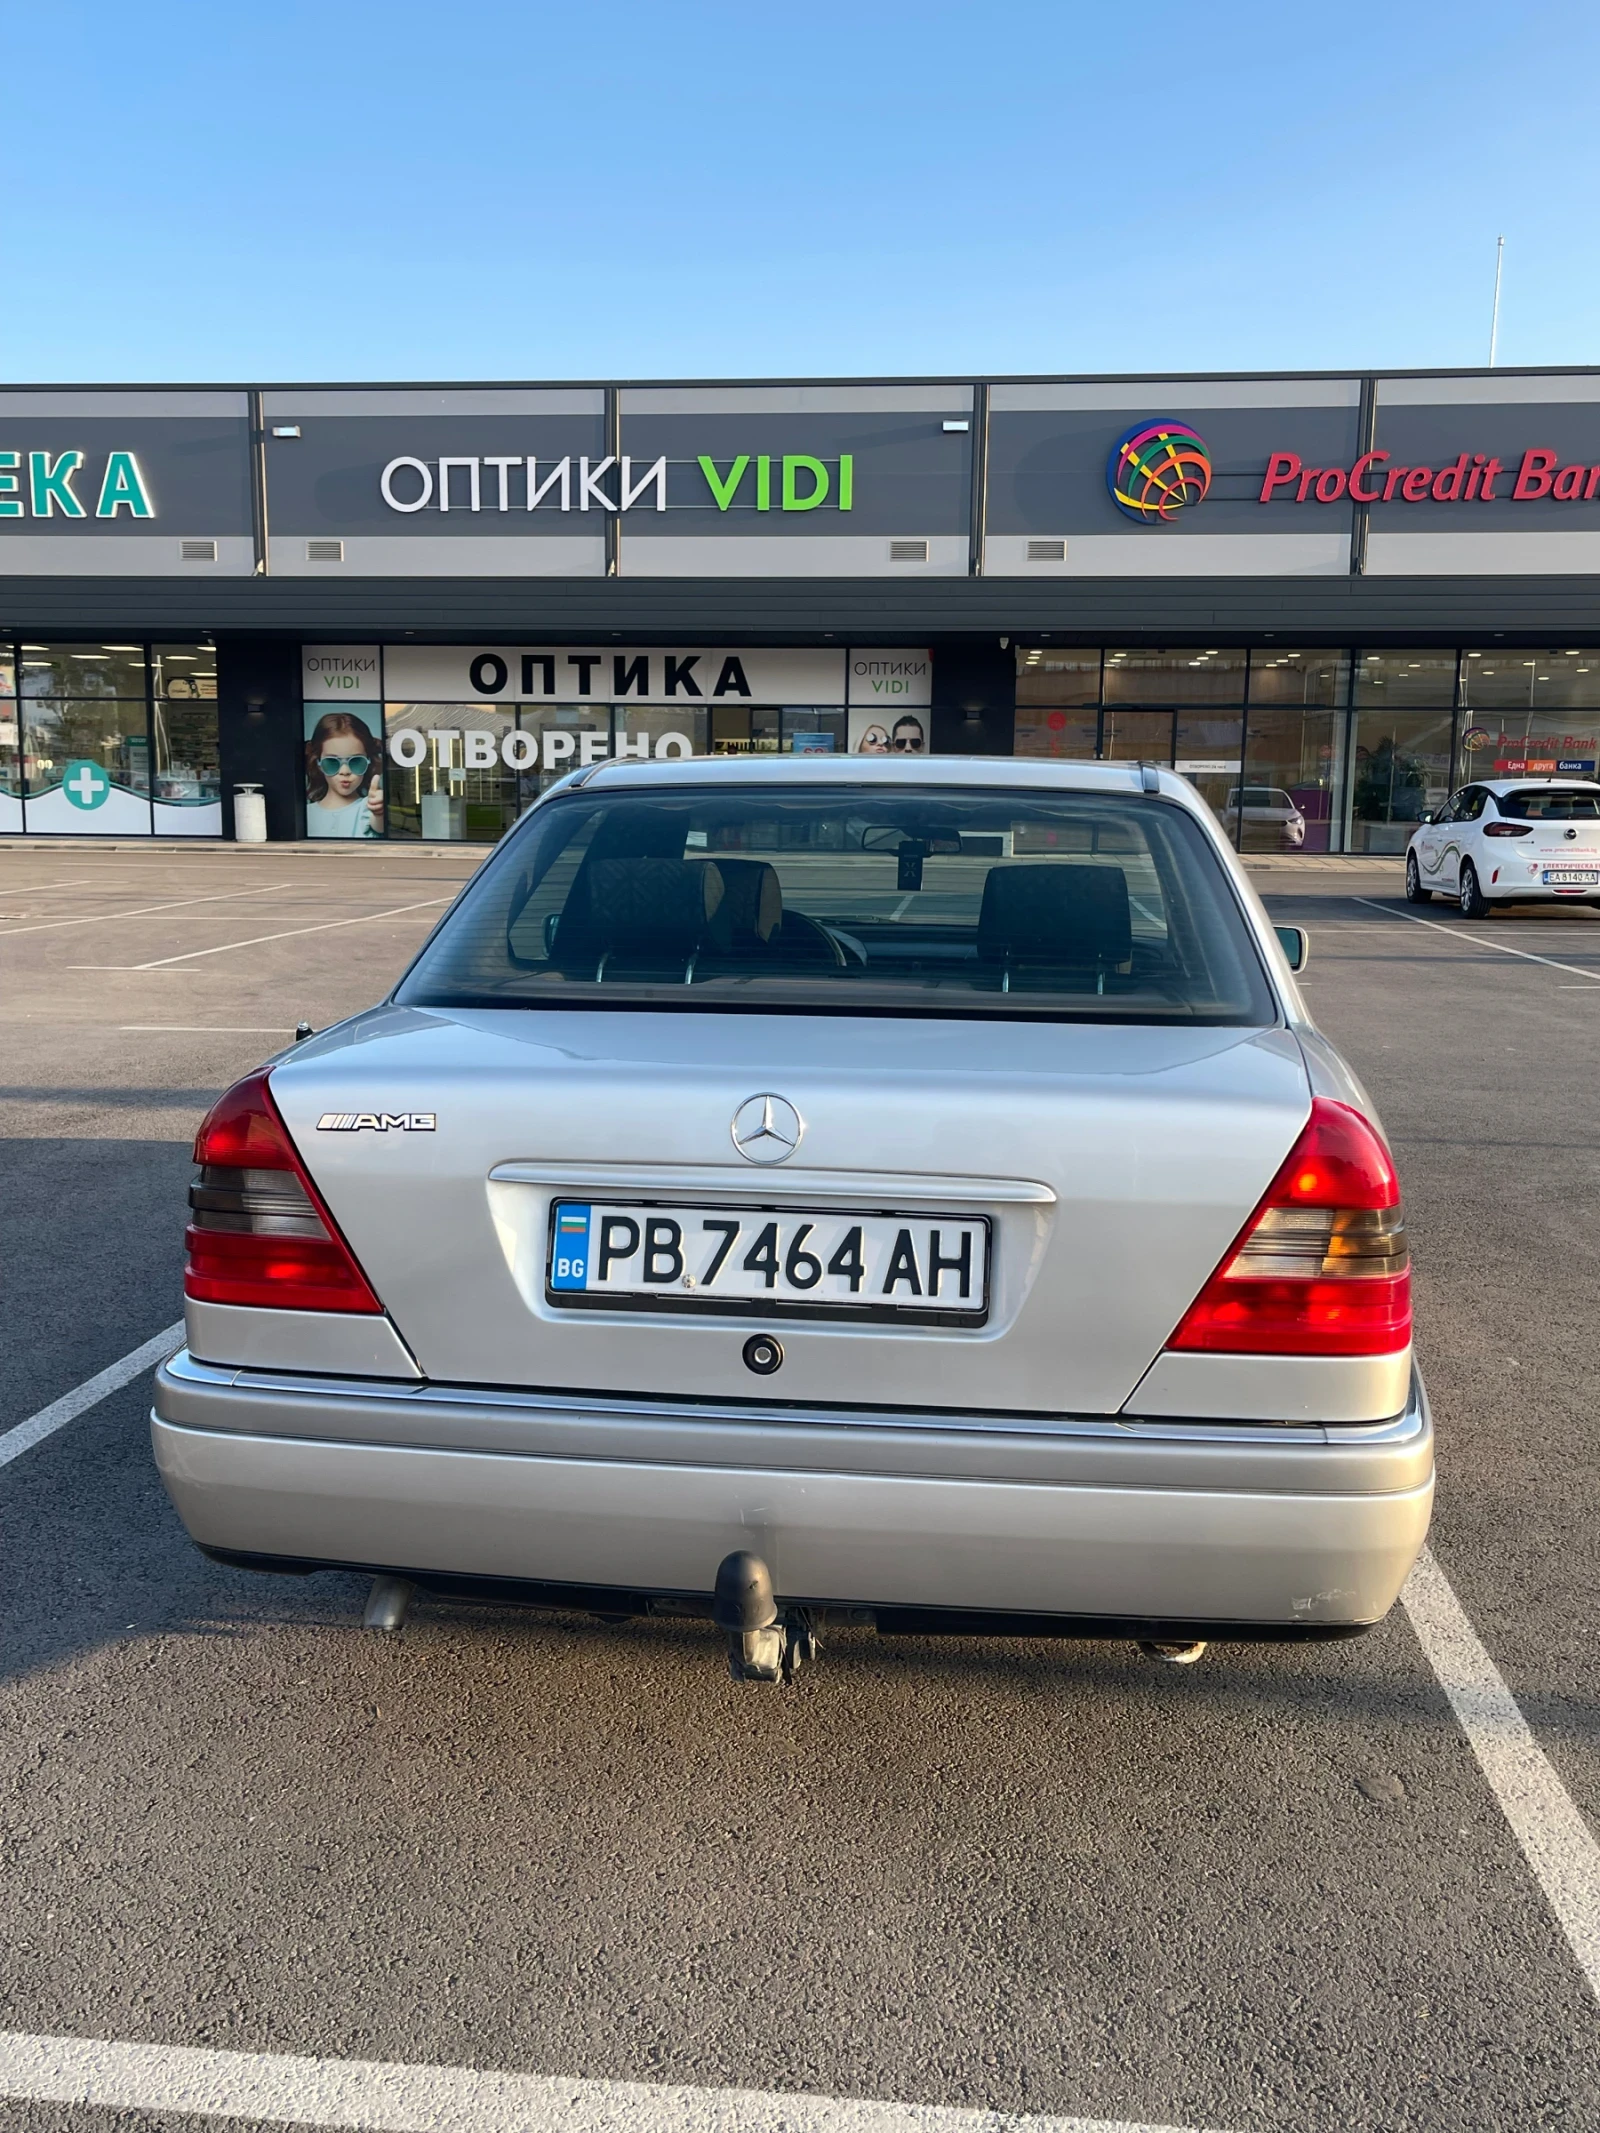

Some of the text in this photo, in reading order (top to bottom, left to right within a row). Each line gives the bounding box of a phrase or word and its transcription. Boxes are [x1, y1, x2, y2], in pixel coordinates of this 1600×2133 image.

[380, 455, 853, 513] ОПТИКИ VIDI
[1259, 450, 1504, 503] ProCredit
[307, 658, 376, 672] ОПТИКИ
[854, 661, 926, 676] ОПТИКИ
[323, 675, 360, 689] VIDI
[468, 653, 752, 697] ОПТИКА
[871, 680, 909, 693] VIDI
[389, 728, 693, 770] ОТВОРЕНО
[1497, 735, 1597, 750] ProCredit Bank
[1507, 761, 1582, 771] Една друга банка
[598, 1215, 973, 1299] PB 7464 AH
[557, 1257, 585, 1279] BG
